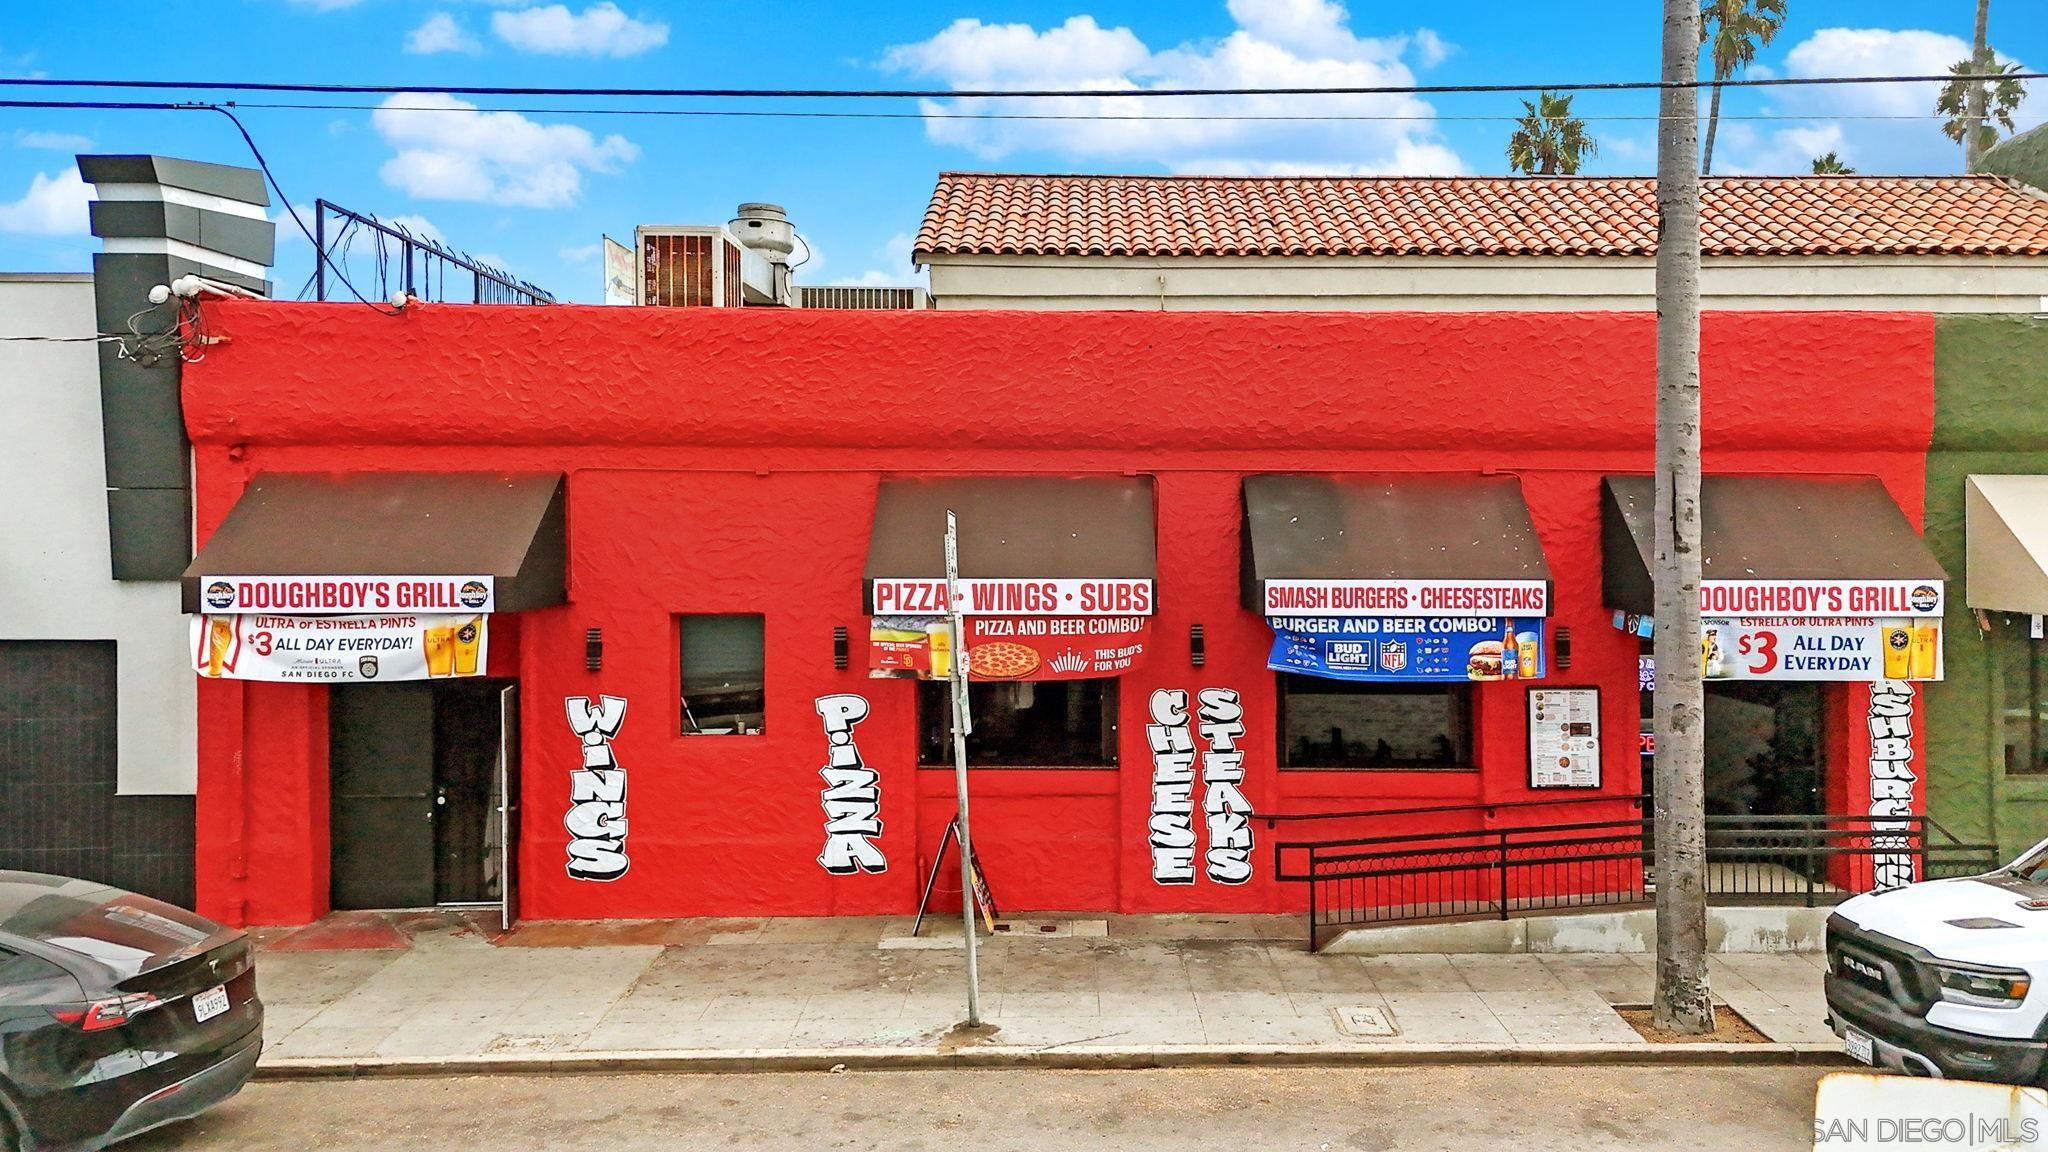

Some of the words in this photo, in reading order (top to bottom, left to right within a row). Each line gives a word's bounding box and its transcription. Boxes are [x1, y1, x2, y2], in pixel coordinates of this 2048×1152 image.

[238, 582, 390, 608] DOUGHBOY'S
[396, 582, 460, 608] GRILL
[877, 583, 949, 611] PIZZA
[971, 583, 1058, 611] WINGS
[1080, 583, 1149, 611] SUBS
[1268, 586, 1328, 609] SMASH
[1331, 586, 1408, 609] BURGERS
[1420, 586, 1544, 610] CHEESESTEAKS
[1700, 586, 1842, 612] DOUGHBOY'S
[1849, 586, 1911, 612] GRILL
[255, 616, 295, 629] ULTRA
[299, 620, 314, 629] or
[316, 618, 377, 630] ESTRELLA
[380, 616, 417, 629] PINTS
[975, 620, 1014, 636] PIZZA
[1017, 619, 1047, 636] AND
[1050, 619, 1086, 635] BEER
[1088, 617, 1145, 635] COMBO!
[1272, 617, 1340, 633] BURGER
[1342, 619, 1380, 633] AND
[1382, 619, 1426, 633] BEER
[1429, 617, 1497, 633] COMBO!
[1740, 616, 1789, 627] ESTRELLA
[1791, 617, 1806, 627] OR
[1809, 616, 1841, 627] ULTRA
[1844, 616, 1874, 627] PINTS
[248, 631, 273, 657] $3
[275, 638, 301, 651] ALL
[305, 638, 336, 651] DAY
[338, 636, 413, 651] EVERYDAY!
[1094, 648, 1116, 660] THIS
[1117, 644, 1143, 658] BUD'S
[1334, 643, 1363, 654] BUD
[1793, 635, 1826, 651] ALL
[1831, 636, 1865, 651] DAY
[1328, 652, 1368, 664] LIGHT
[1384, 654, 1404, 668] NFL
[1738, 631, 1778, 674] $3
[1094, 660, 1113, 671] FOR
[1114, 657, 1132, 669] YOU
[1784, 654, 1872, 671] EVERYDAY
[1146, 688, 1196, 885] CHEESE
[1198, 688, 1254, 885] STEAKS
[1843, 955, 1882, 980] RAM
